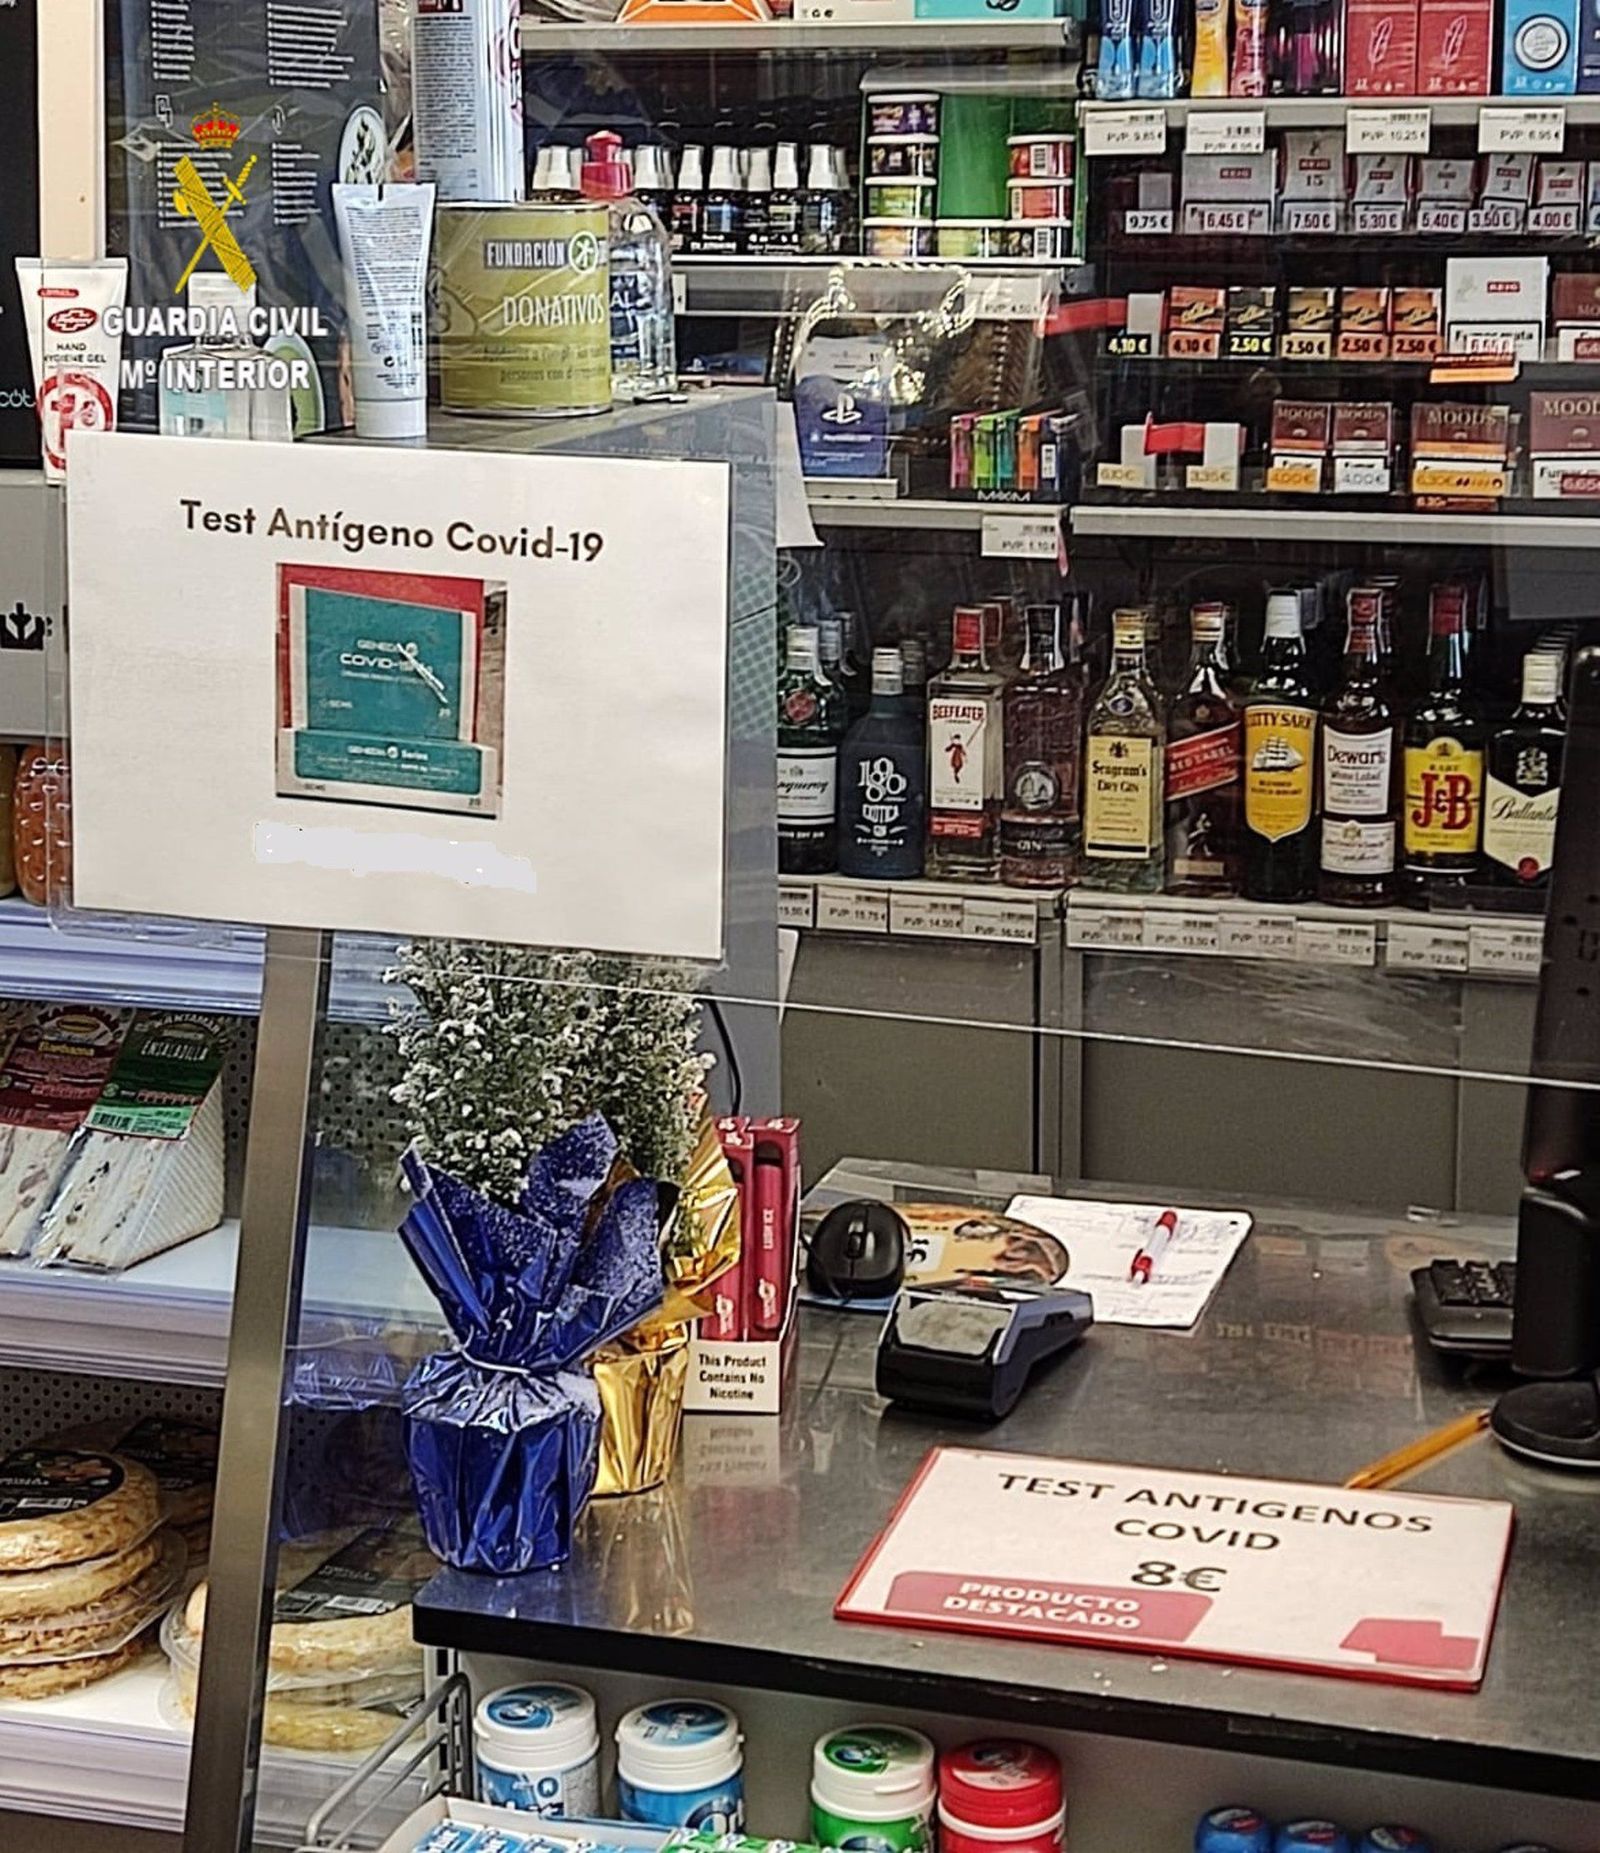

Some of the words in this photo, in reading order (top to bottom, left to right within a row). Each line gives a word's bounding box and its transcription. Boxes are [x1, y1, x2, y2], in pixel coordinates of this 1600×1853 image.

[1160, 212, 1169, 228] €
[1206, 212, 1234, 229] 6.45
[1236, 213, 1245, 228] €
[1294, 212, 1320, 229] 7.50
[1322, 213, 1331, 228] €
[1359, 213, 1387, 229] 5.30
[1389, 214, 1398, 228] €
[1422, 212, 1450, 228] 5.40
[1450, 213, 1459, 227] €
[1472, 211, 1501, 228] 3.50
[1502, 211, 1511, 227] €
[1532, 212, 1563, 227] 4.00
[1564, 212, 1573, 227] €
[487, 239, 565, 267] FUNDACIÓN
[503, 293, 605, 327] DONATIVOS
[56, 343, 87, 351] HAND
[1138, 339, 1148, 353] €
[1202, 339, 1211, 352] €
[1230, 337, 1258, 352] 2.50
[1261, 337, 1271, 352] €
[1286, 341, 1313, 354] 2.50
[1315, 341, 1326, 355] €
[1342, 338, 1371, 353] 2.50
[1373, 339, 1383, 352] €
[1396, 338, 1425, 353] 2.50
[1427, 339, 1437, 353] €
[87, 355, 107, 363] GEL
[1427, 410, 1498, 425] MOODS
[180, 499, 257, 535] Test
[266, 507, 434, 553] Antígeno
[446, 520, 605, 562] Covid-19
[699, 1353, 721, 1367] This
[724, 1355, 766, 1367] Product
[699, 1369, 746, 1384] Contains
[749, 1372, 765, 1384] No
[709, 1386, 754, 1400] Nicotine
[998, 1473, 1116, 1500] TEST
[1124, 1489, 1433, 1534] ANTIGENOS
[1114, 1519, 1281, 1552] COVID
[1131, 1561, 1229, 1593] 8€
[958, 1581, 1141, 1613] PRODUCTO
[942, 1595, 1141, 1631] DESTACADO
